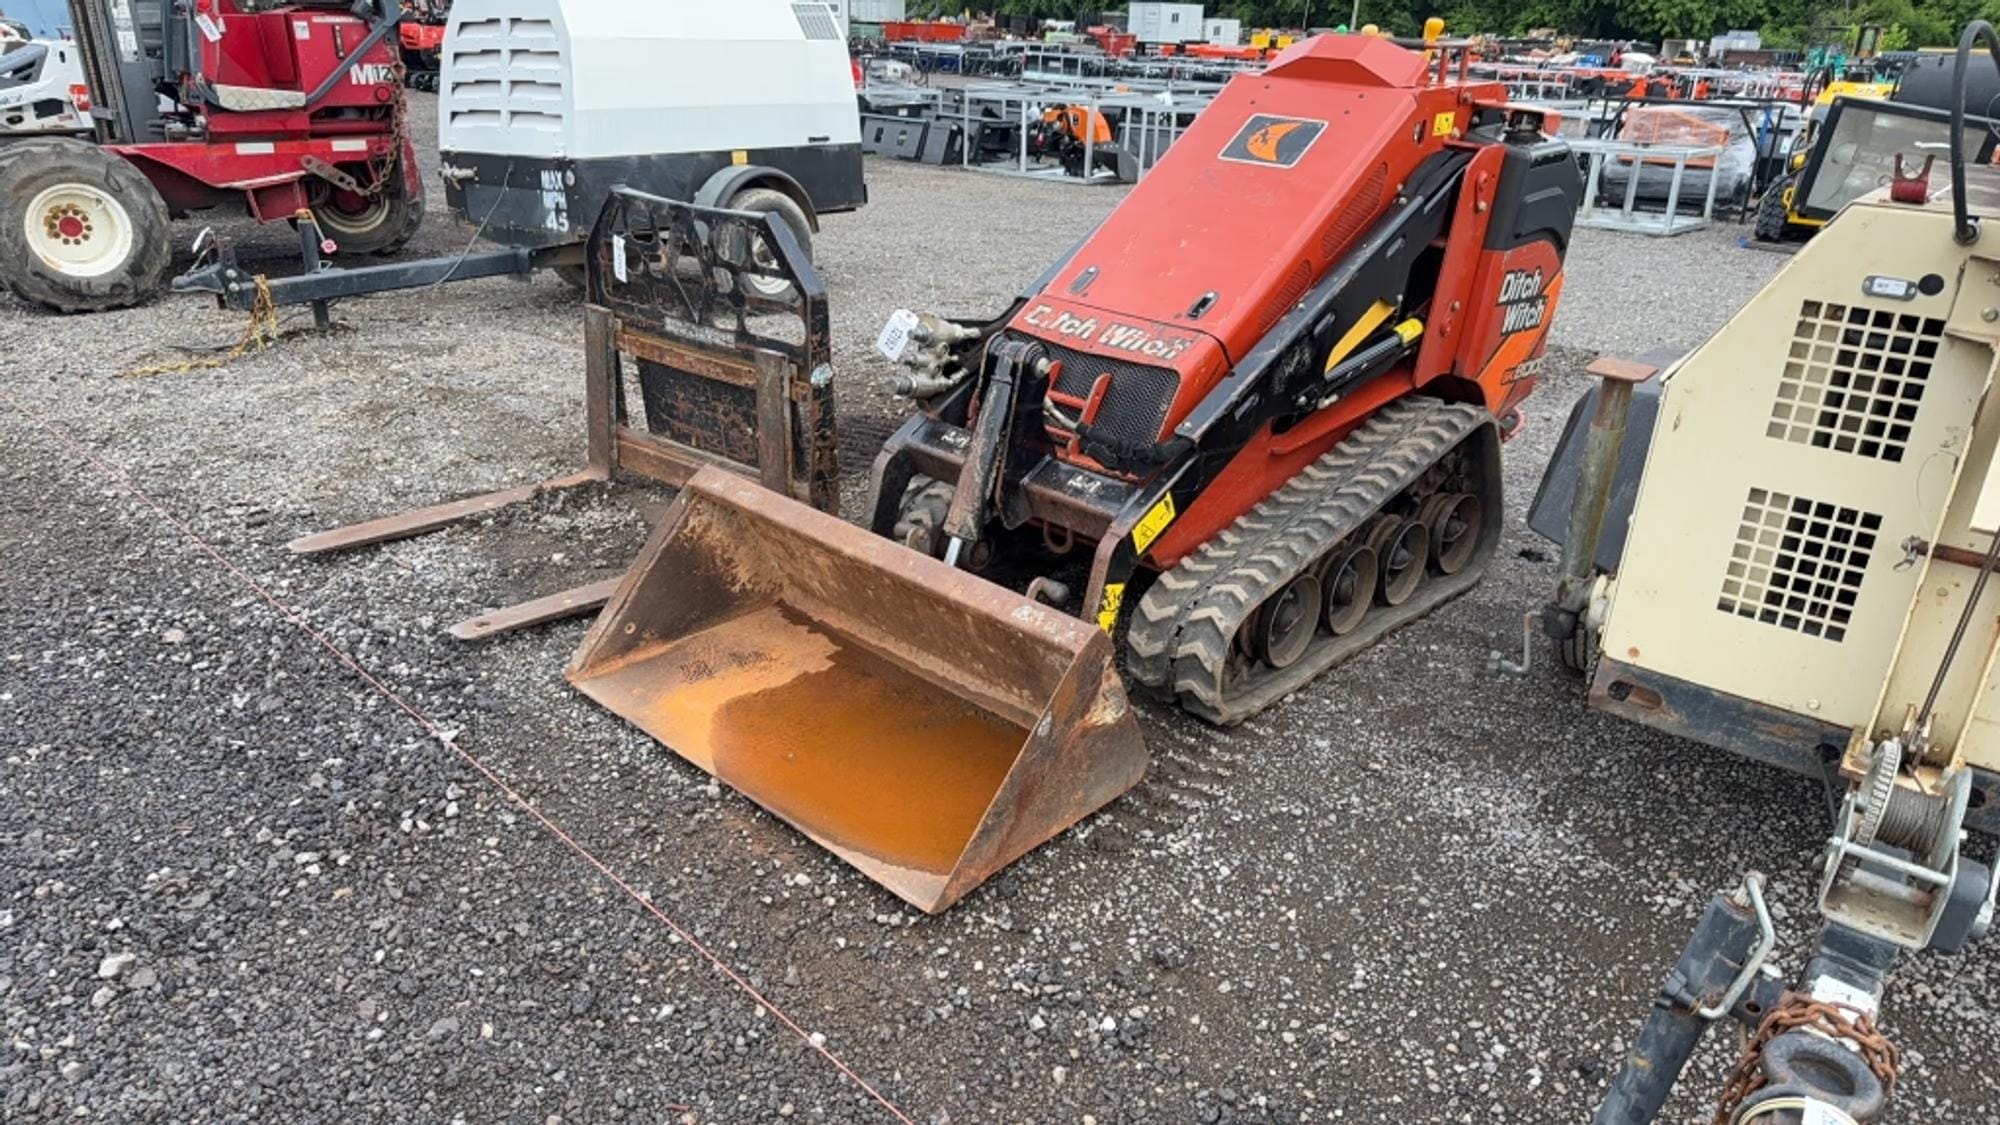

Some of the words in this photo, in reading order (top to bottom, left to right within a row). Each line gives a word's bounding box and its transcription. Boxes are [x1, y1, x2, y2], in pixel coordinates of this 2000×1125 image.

[541, 170, 564, 190] MAX
[546, 210, 569, 232] 45
[1498, 268, 1542, 304] Ditch
[1501, 298, 1546, 334] Witch
